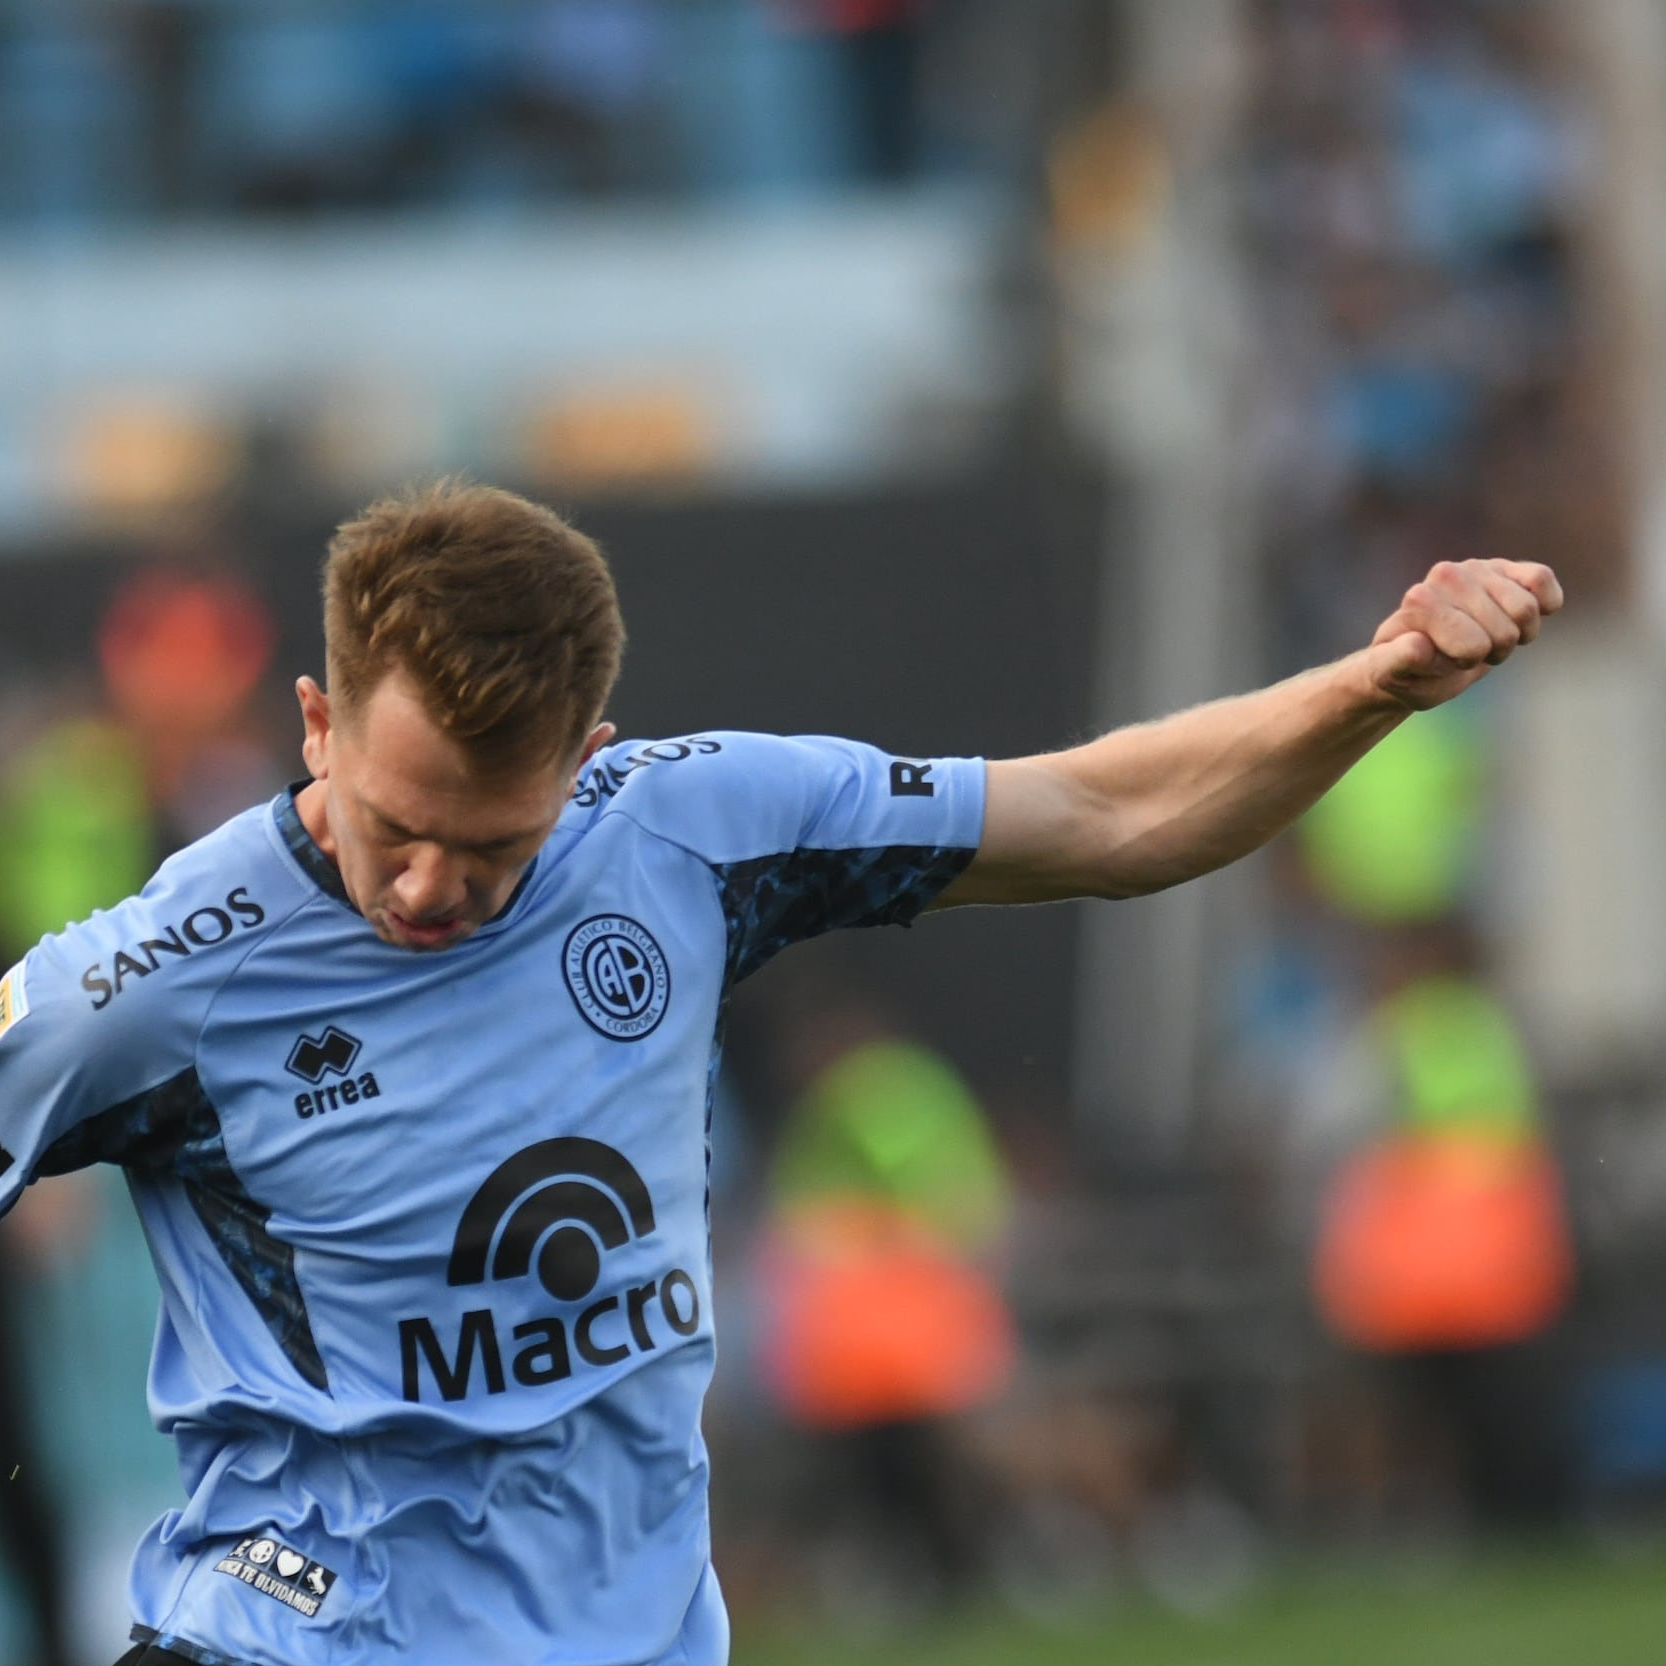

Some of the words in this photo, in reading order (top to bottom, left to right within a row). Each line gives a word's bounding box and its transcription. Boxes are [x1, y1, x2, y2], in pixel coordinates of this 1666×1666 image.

[889, 761, 934, 798] R
[81, 887, 266, 1011] SANOS
[294, 1072, 381, 1119] errea
[398, 1268, 700, 1404] Macro
[254, 1573, 319, 1616] OLVIDAMOS
